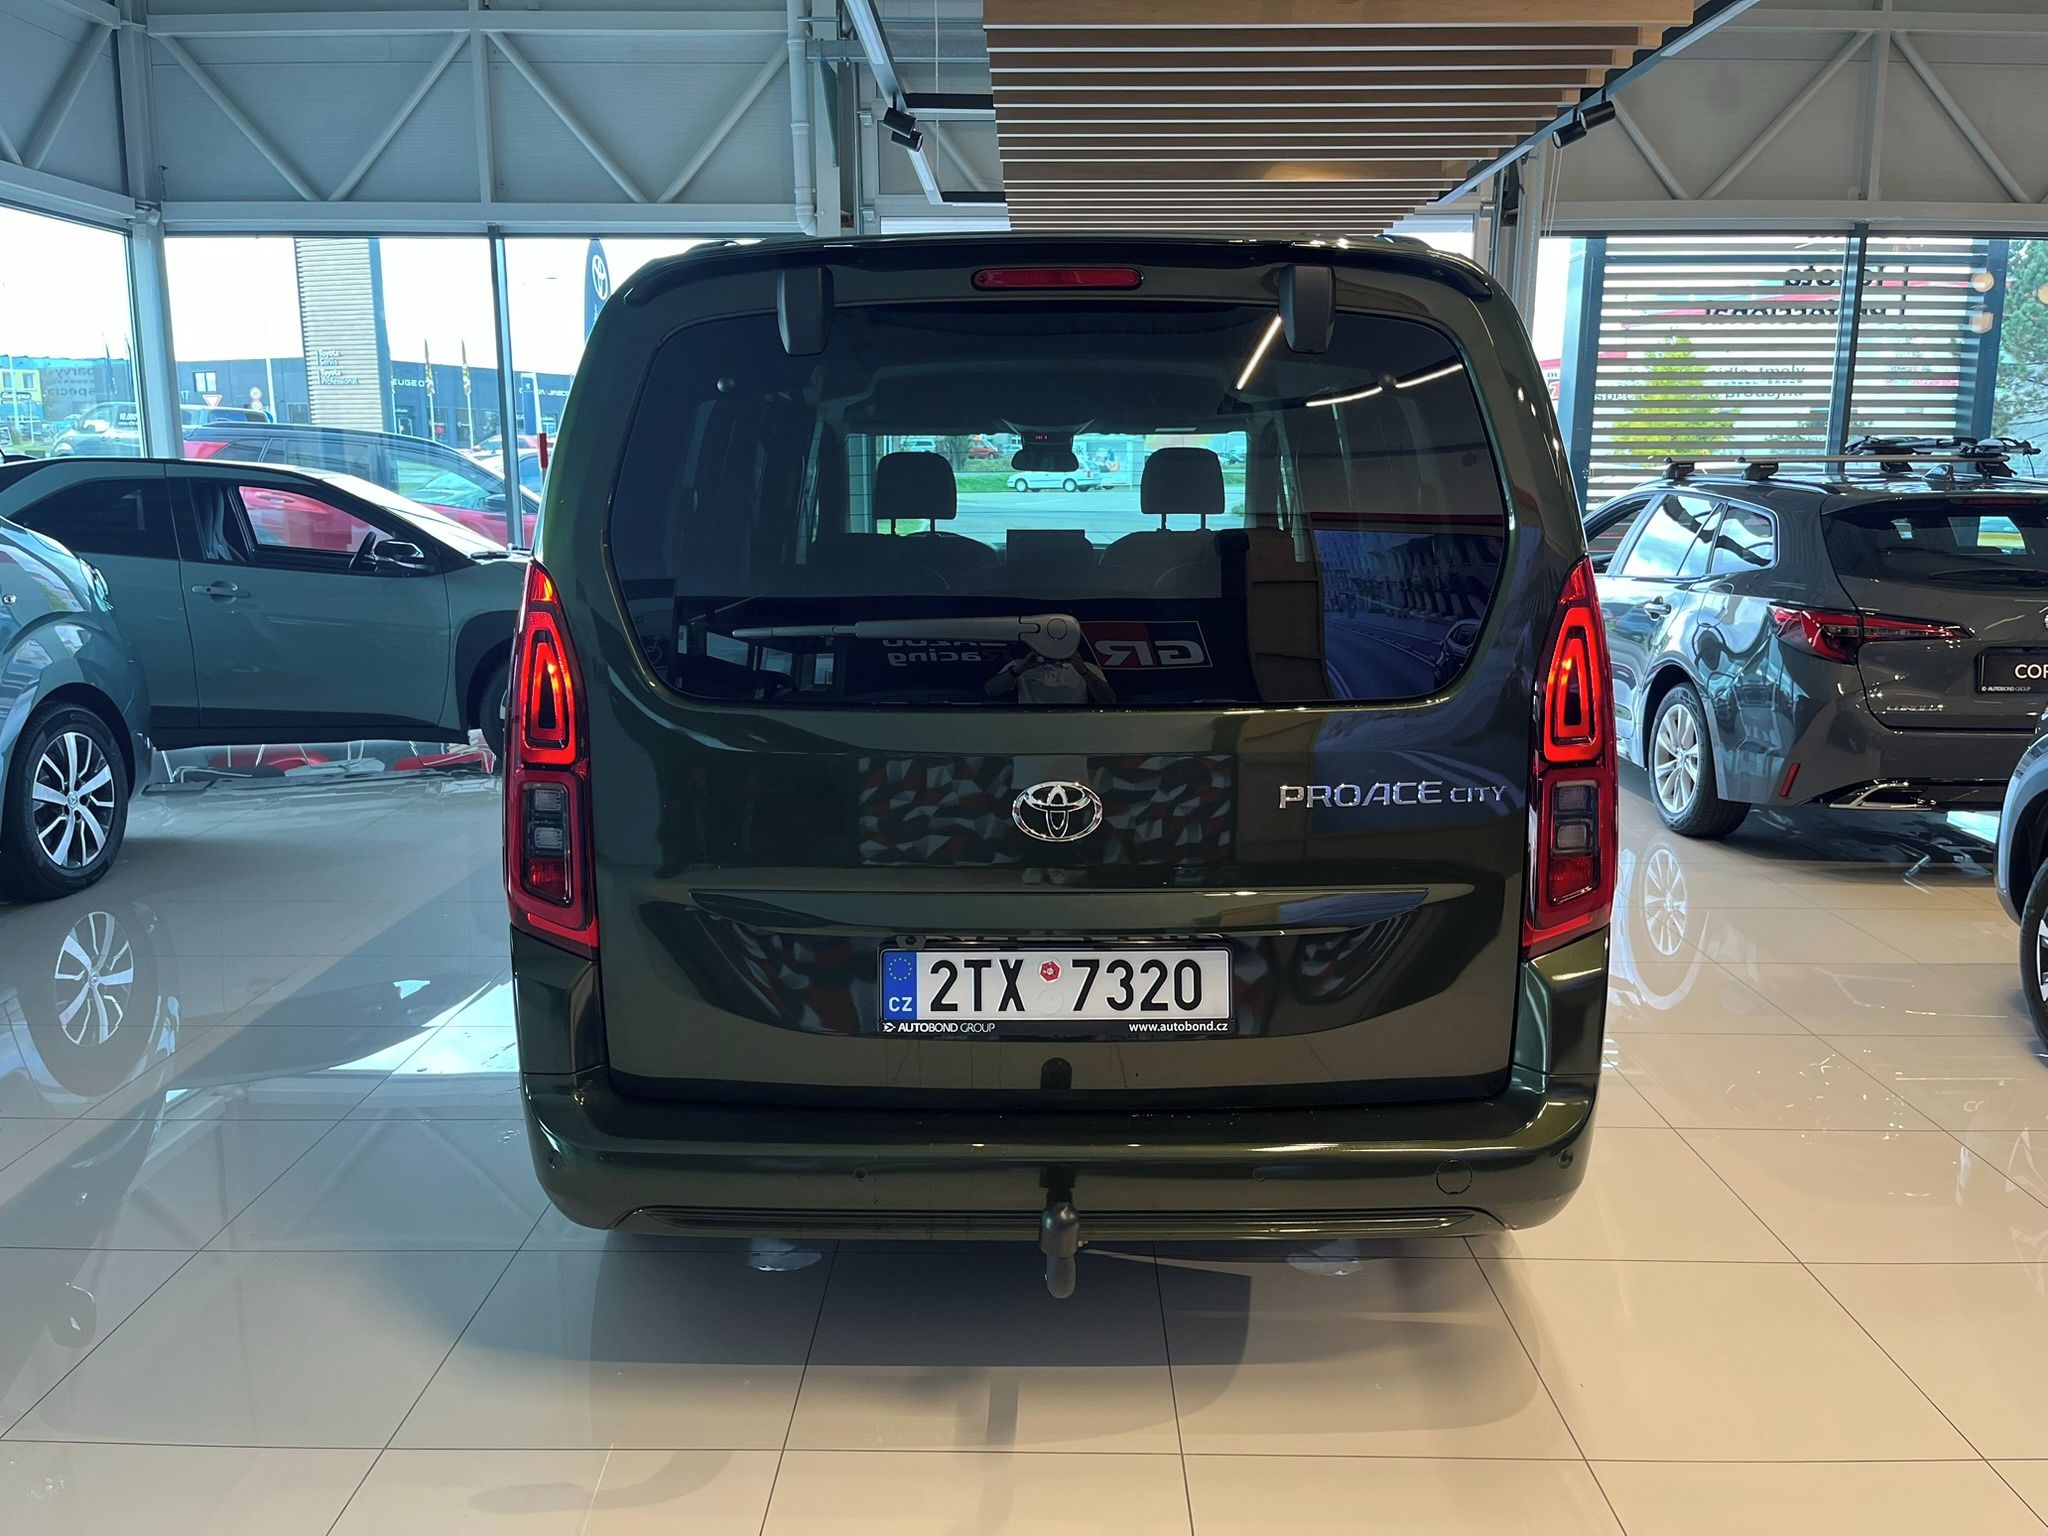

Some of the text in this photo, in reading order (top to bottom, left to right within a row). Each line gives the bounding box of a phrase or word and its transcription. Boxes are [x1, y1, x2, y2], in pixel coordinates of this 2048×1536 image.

[1279, 780, 1508, 809] PROACE CITY
[930, 959, 1202, 1012] 2TX 7320
[888, 997, 913, 1012] CZ
[898, 1022, 996, 1033] AUTOBOND GROUP
[1128, 1021, 1229, 1032] www.autobond.cz
